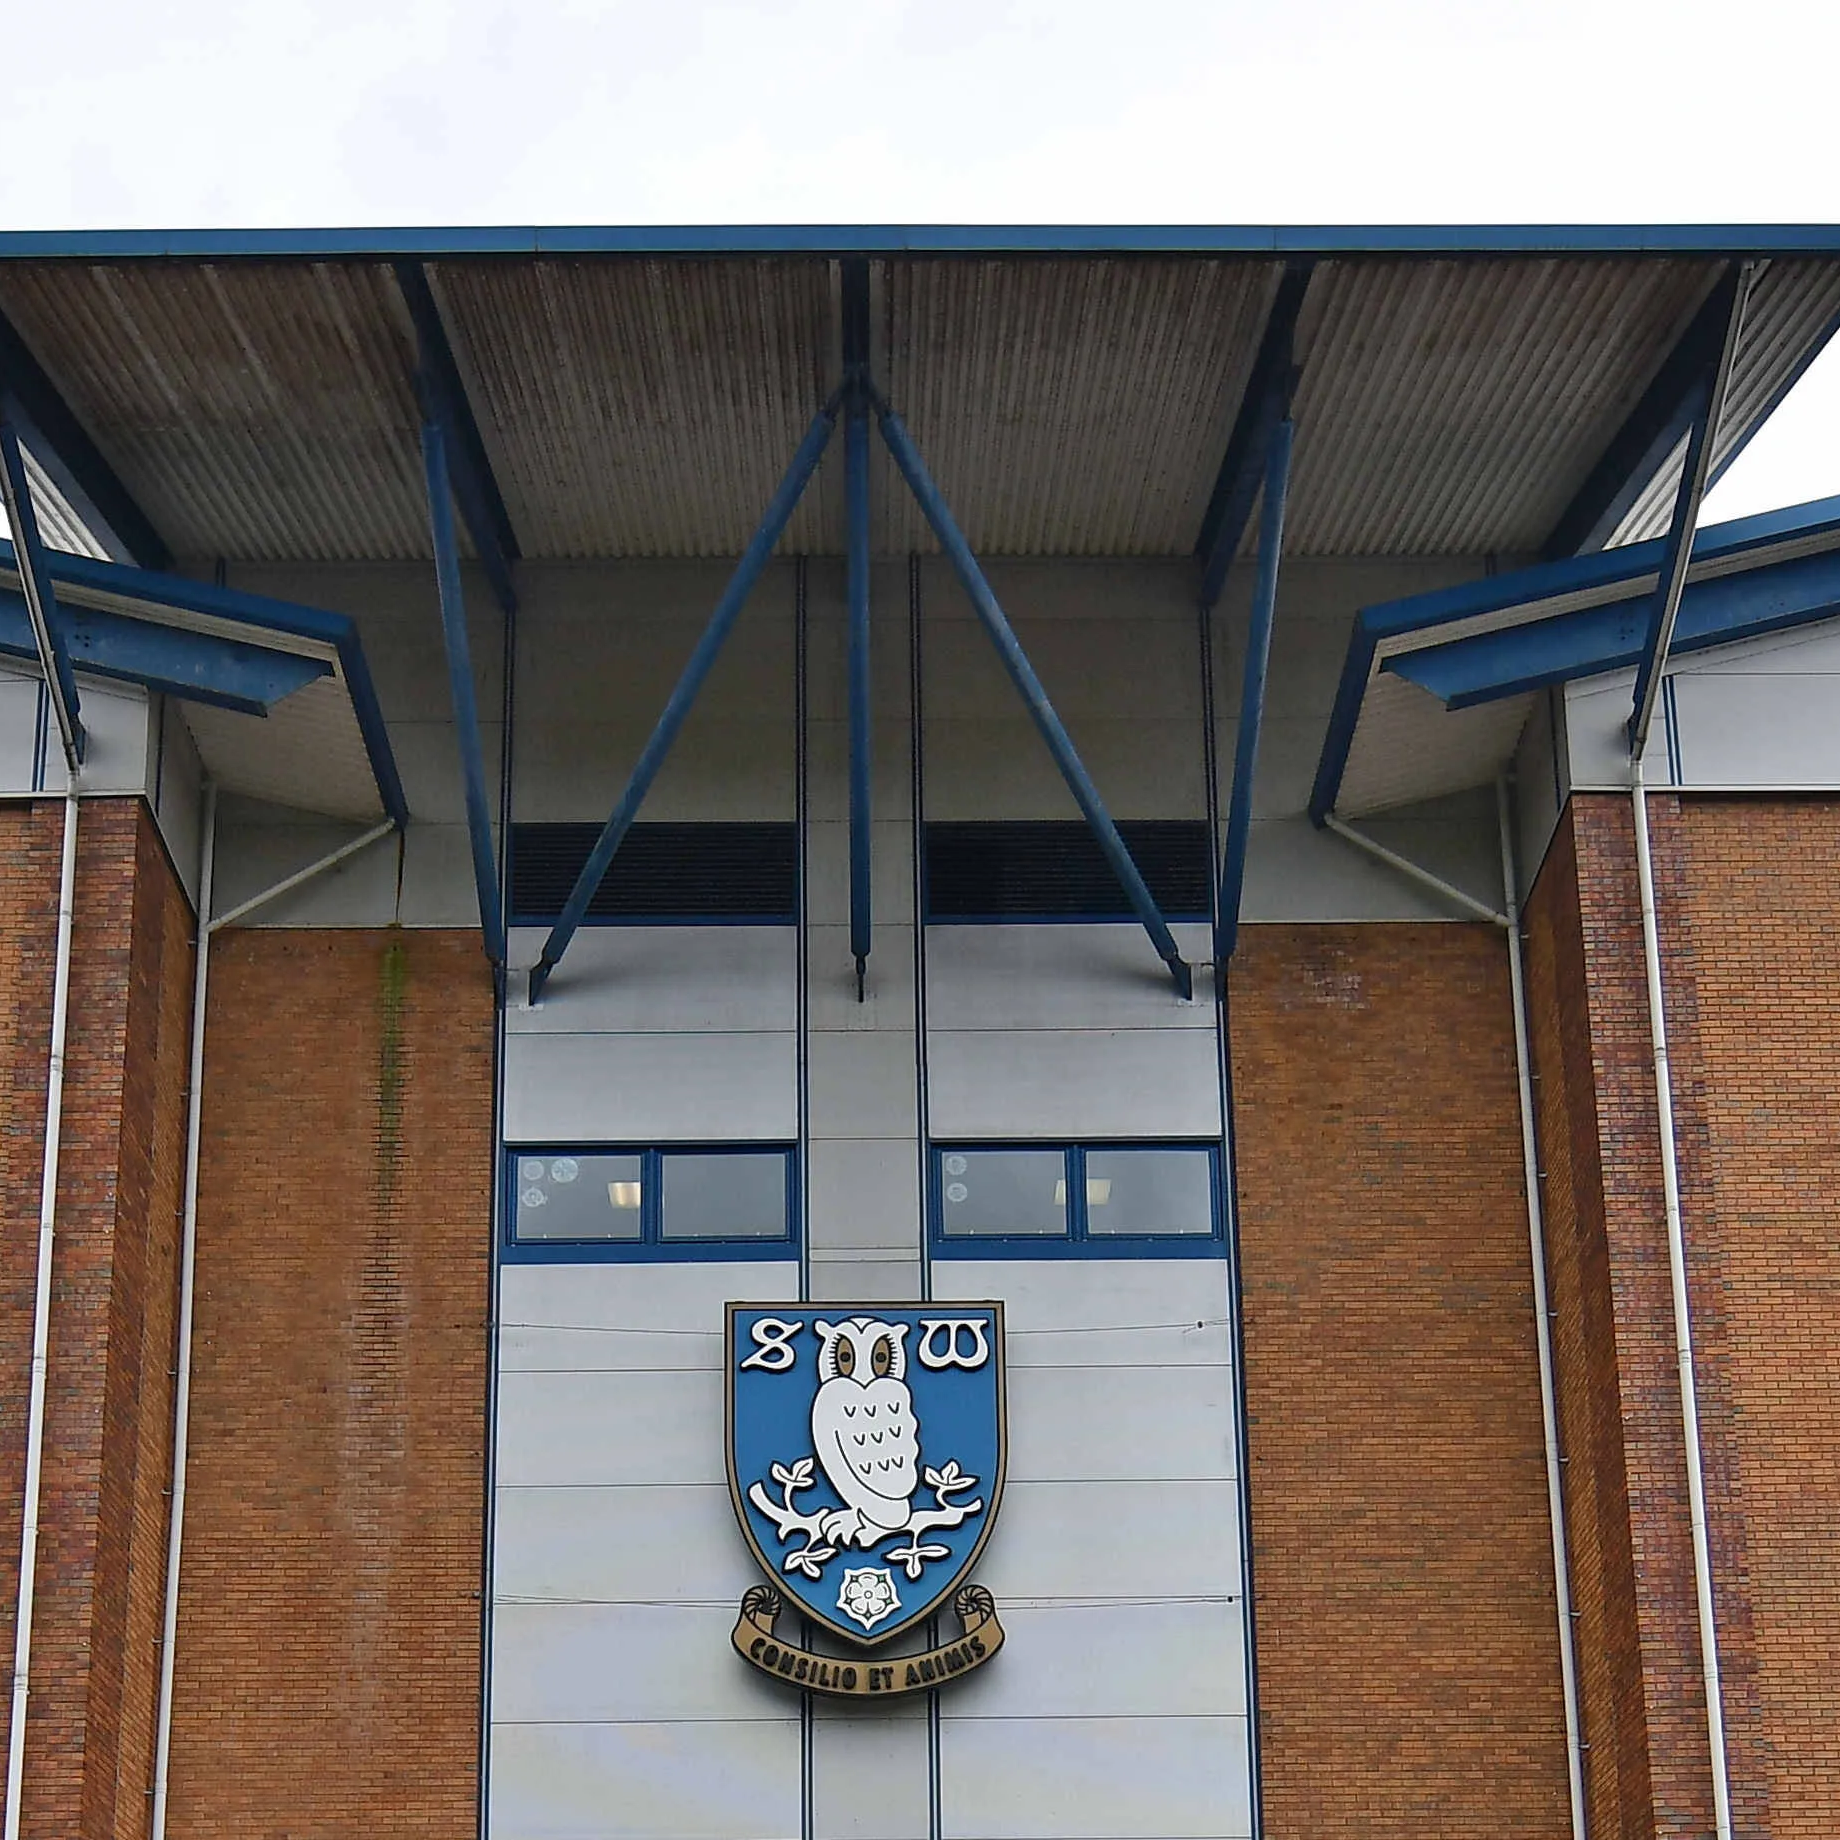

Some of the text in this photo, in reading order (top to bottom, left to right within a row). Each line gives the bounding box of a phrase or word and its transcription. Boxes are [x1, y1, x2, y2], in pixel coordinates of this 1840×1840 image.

[741, 1317, 988, 1371] S W
[750, 1636, 987, 1691] CONSILIO ET ANIMIS
